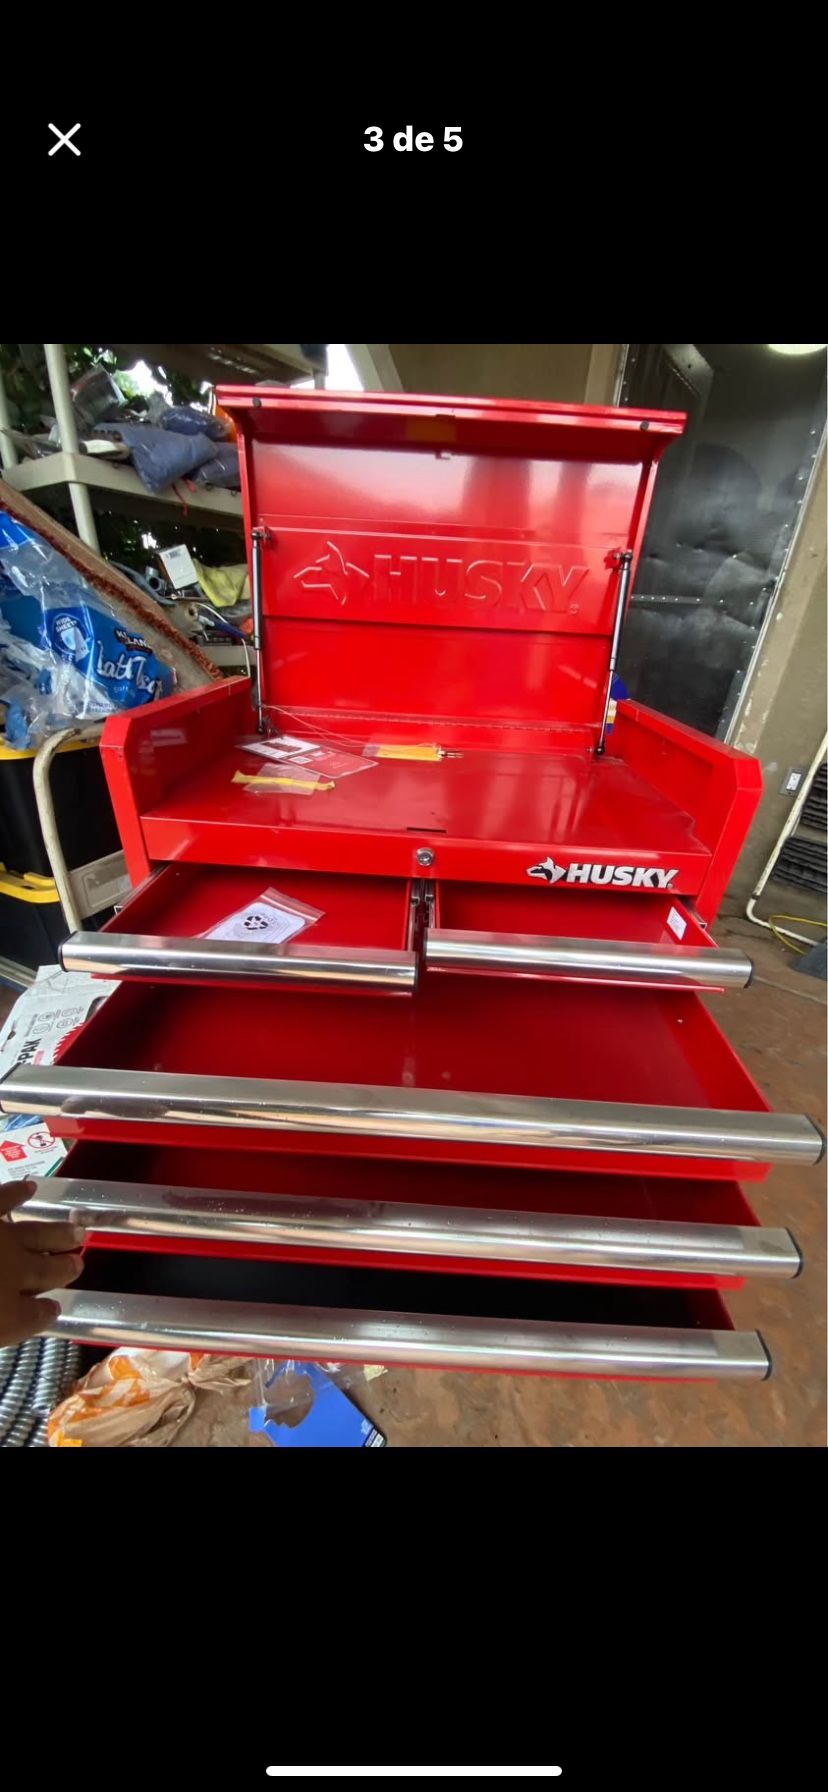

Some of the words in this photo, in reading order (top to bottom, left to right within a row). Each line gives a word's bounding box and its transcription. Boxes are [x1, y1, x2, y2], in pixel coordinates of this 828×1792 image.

[374, 554, 590, 613] HUSKY
[566, 863, 679, 889] HUSKY
[17, 1038, 42, 1065] -PAK
